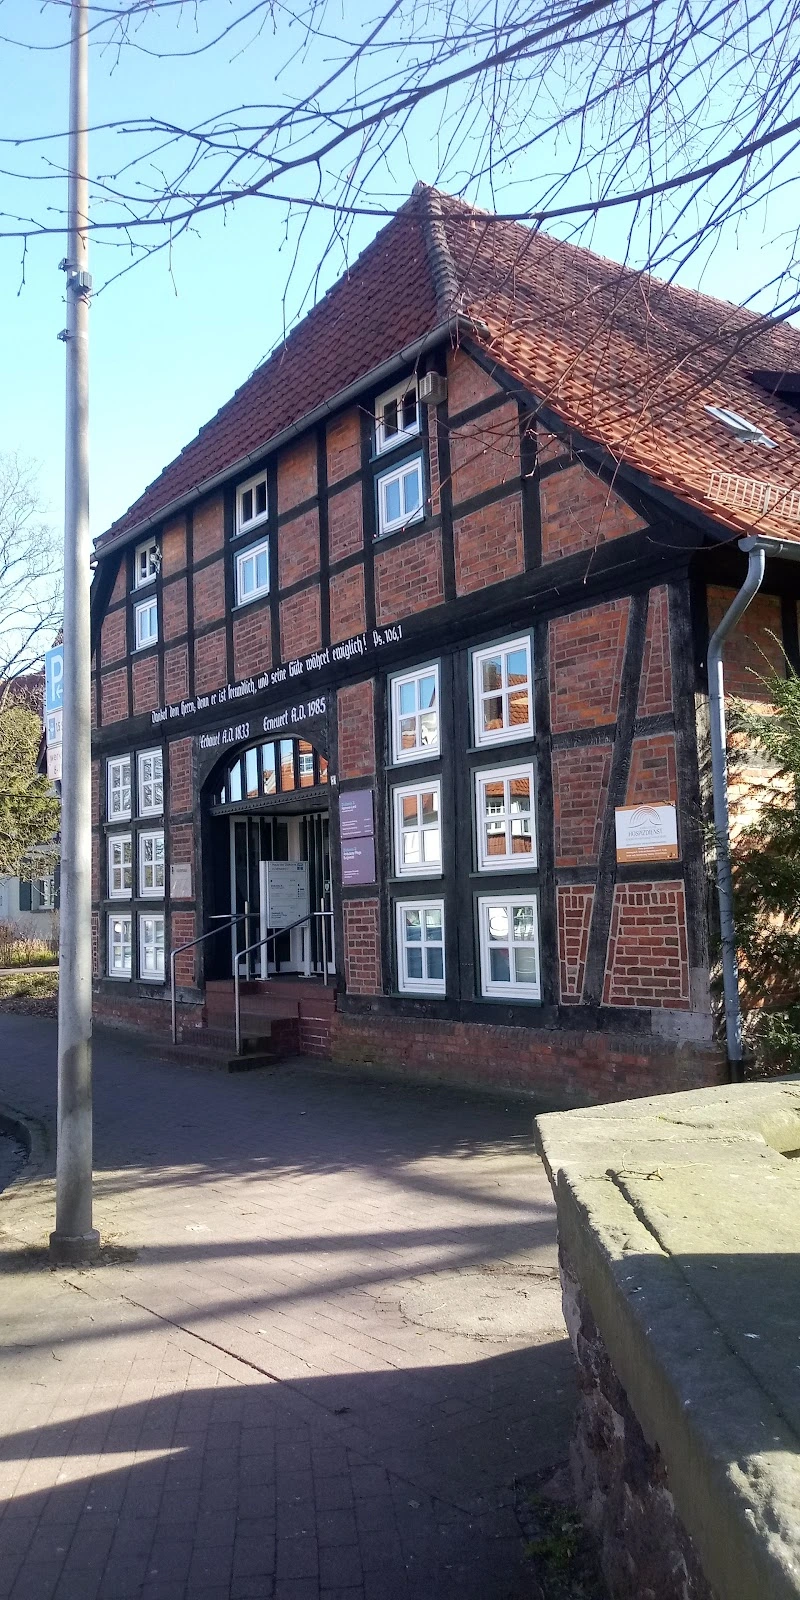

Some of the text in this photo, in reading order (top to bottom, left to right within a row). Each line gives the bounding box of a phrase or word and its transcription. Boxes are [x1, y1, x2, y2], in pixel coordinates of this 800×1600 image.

[51, 655, 63, 701] P
[151, 707, 168, 724] Danket
[169, 705, 180, 718] dem
[197, 696, 209, 710] denn
[210, 693, 217, 705] er
[218, 687, 226, 703] ist
[228, 678, 258, 700] freundlich,
[258, 672, 269, 690] und
[271, 667, 287, 684] seine
[288, 659, 303, 677] Güte
[306, 647, 330, 670] währet
[235, 722, 250, 740] 1833
[263, 696, 326, 731] Erneuert A.D. 1985
